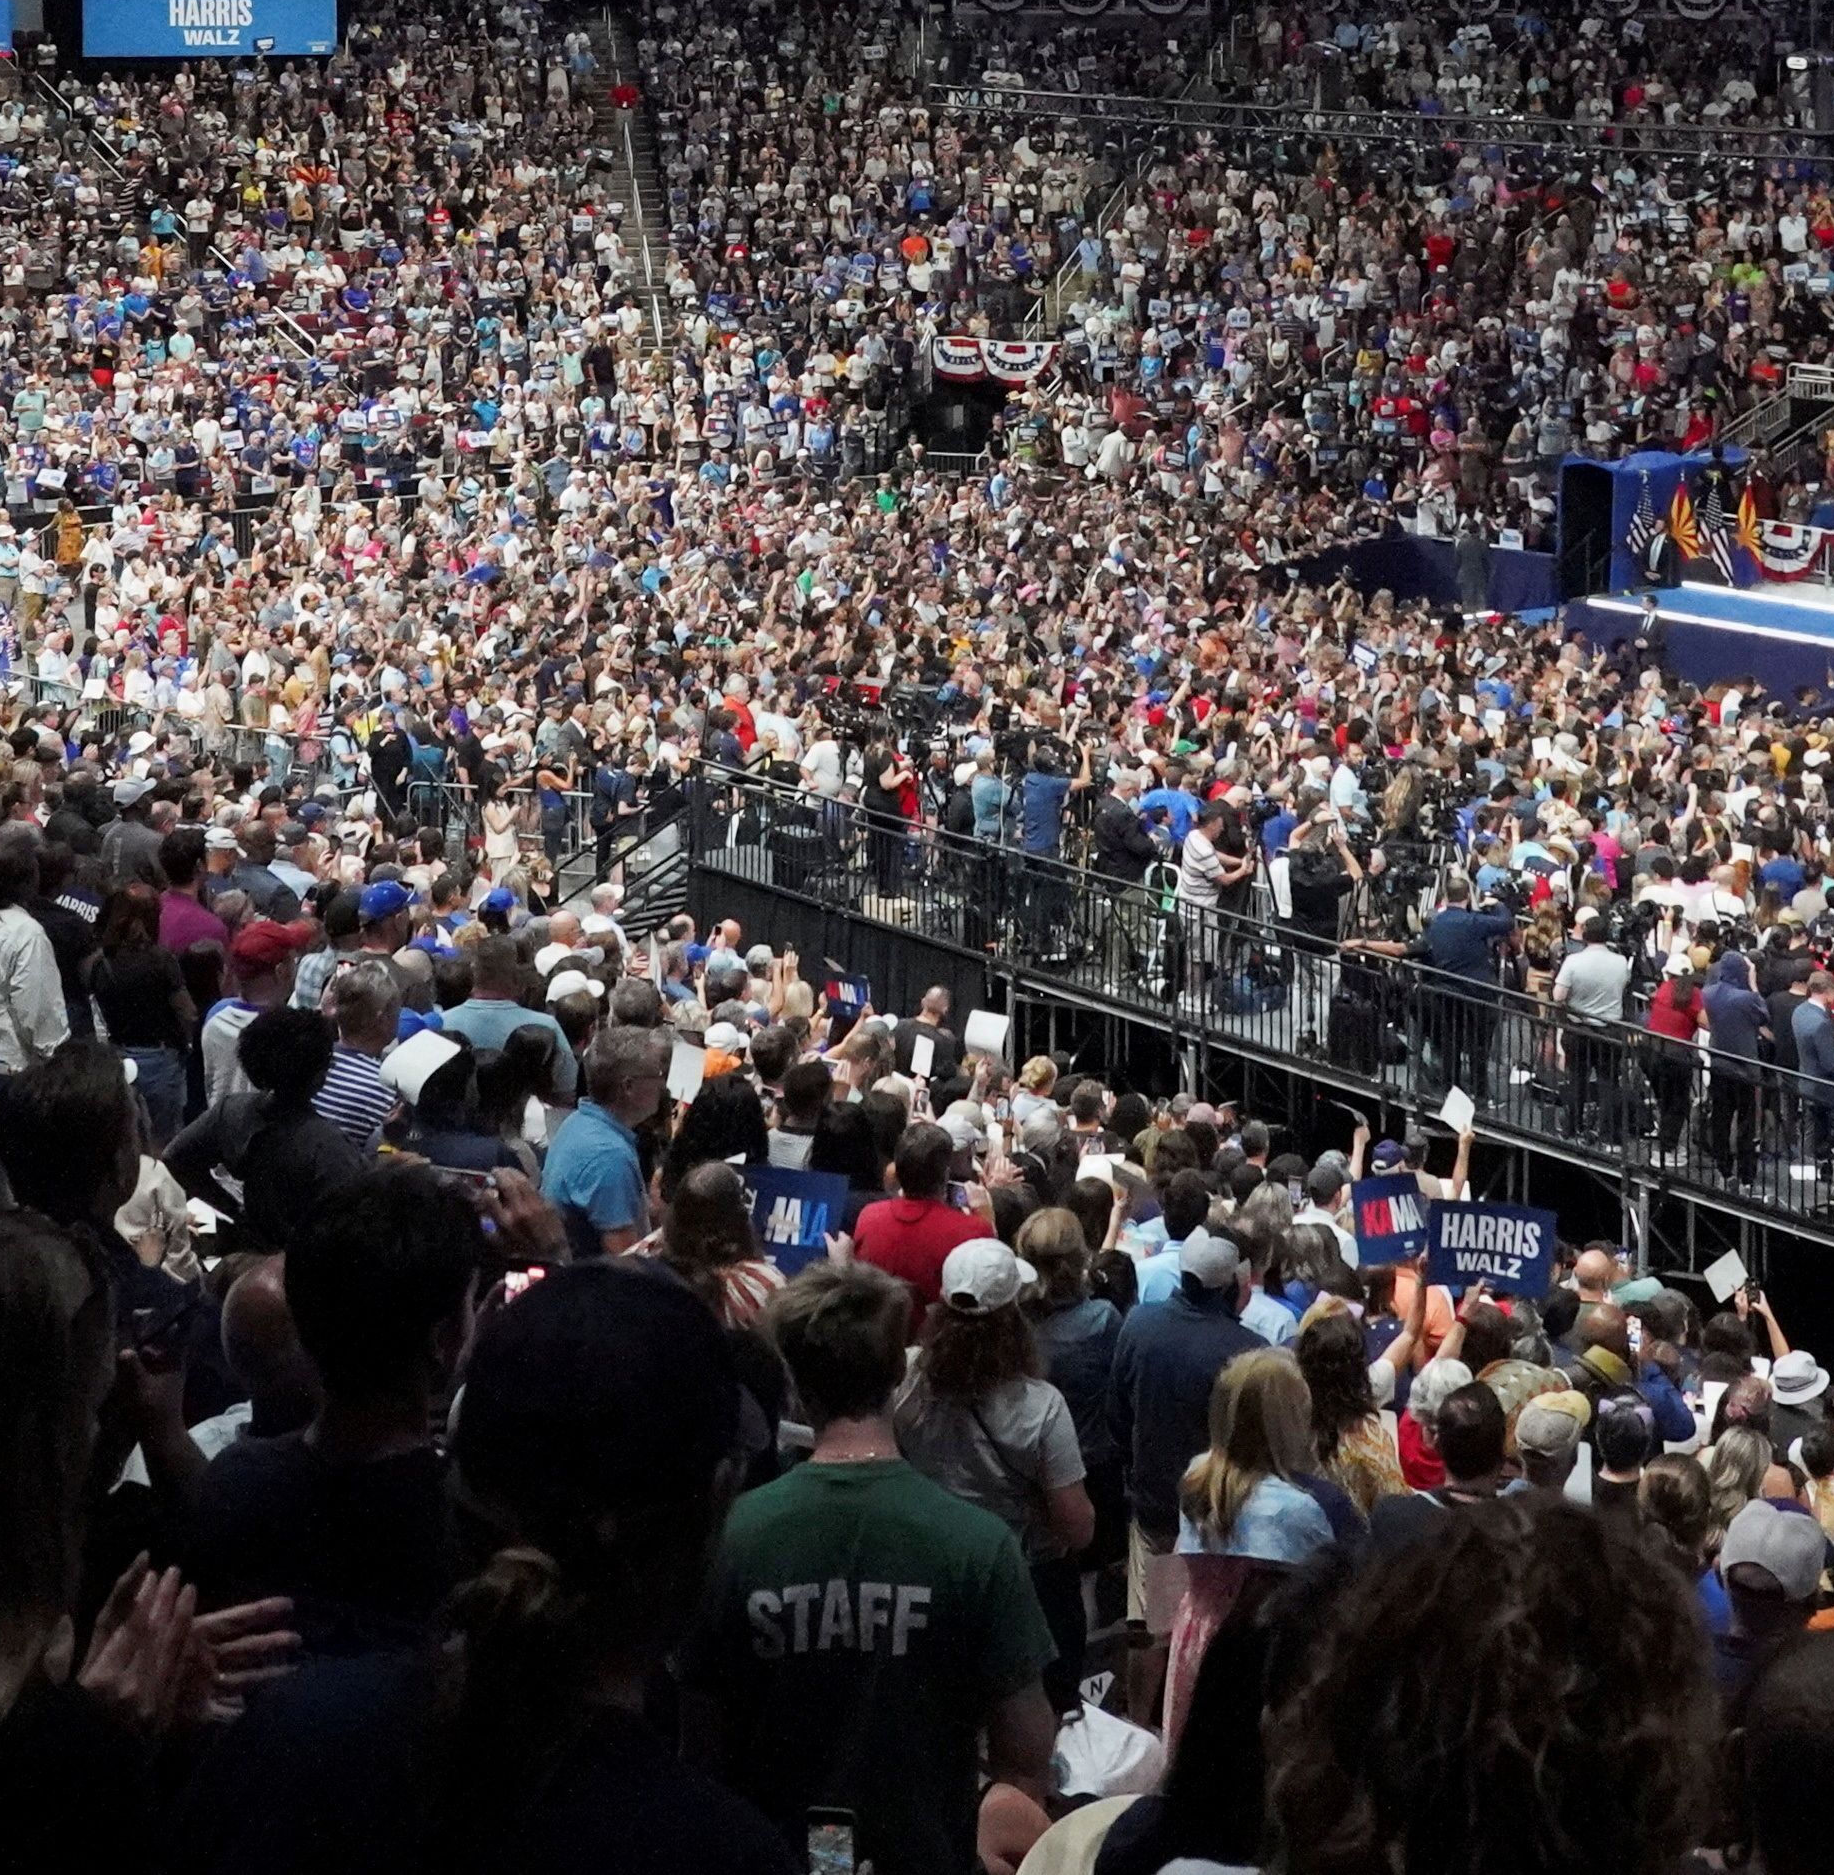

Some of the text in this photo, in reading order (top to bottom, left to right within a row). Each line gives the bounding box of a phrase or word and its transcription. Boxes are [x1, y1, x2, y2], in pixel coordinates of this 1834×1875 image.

[184, 29, 240, 46] WALZ
[1361, 1193, 1425, 1238] KAMA
[1440, 1212, 1541, 1260] HARRIS
[1456, 1252, 1522, 1279] WALZ
[747, 1580, 932, 1656] STAFF
